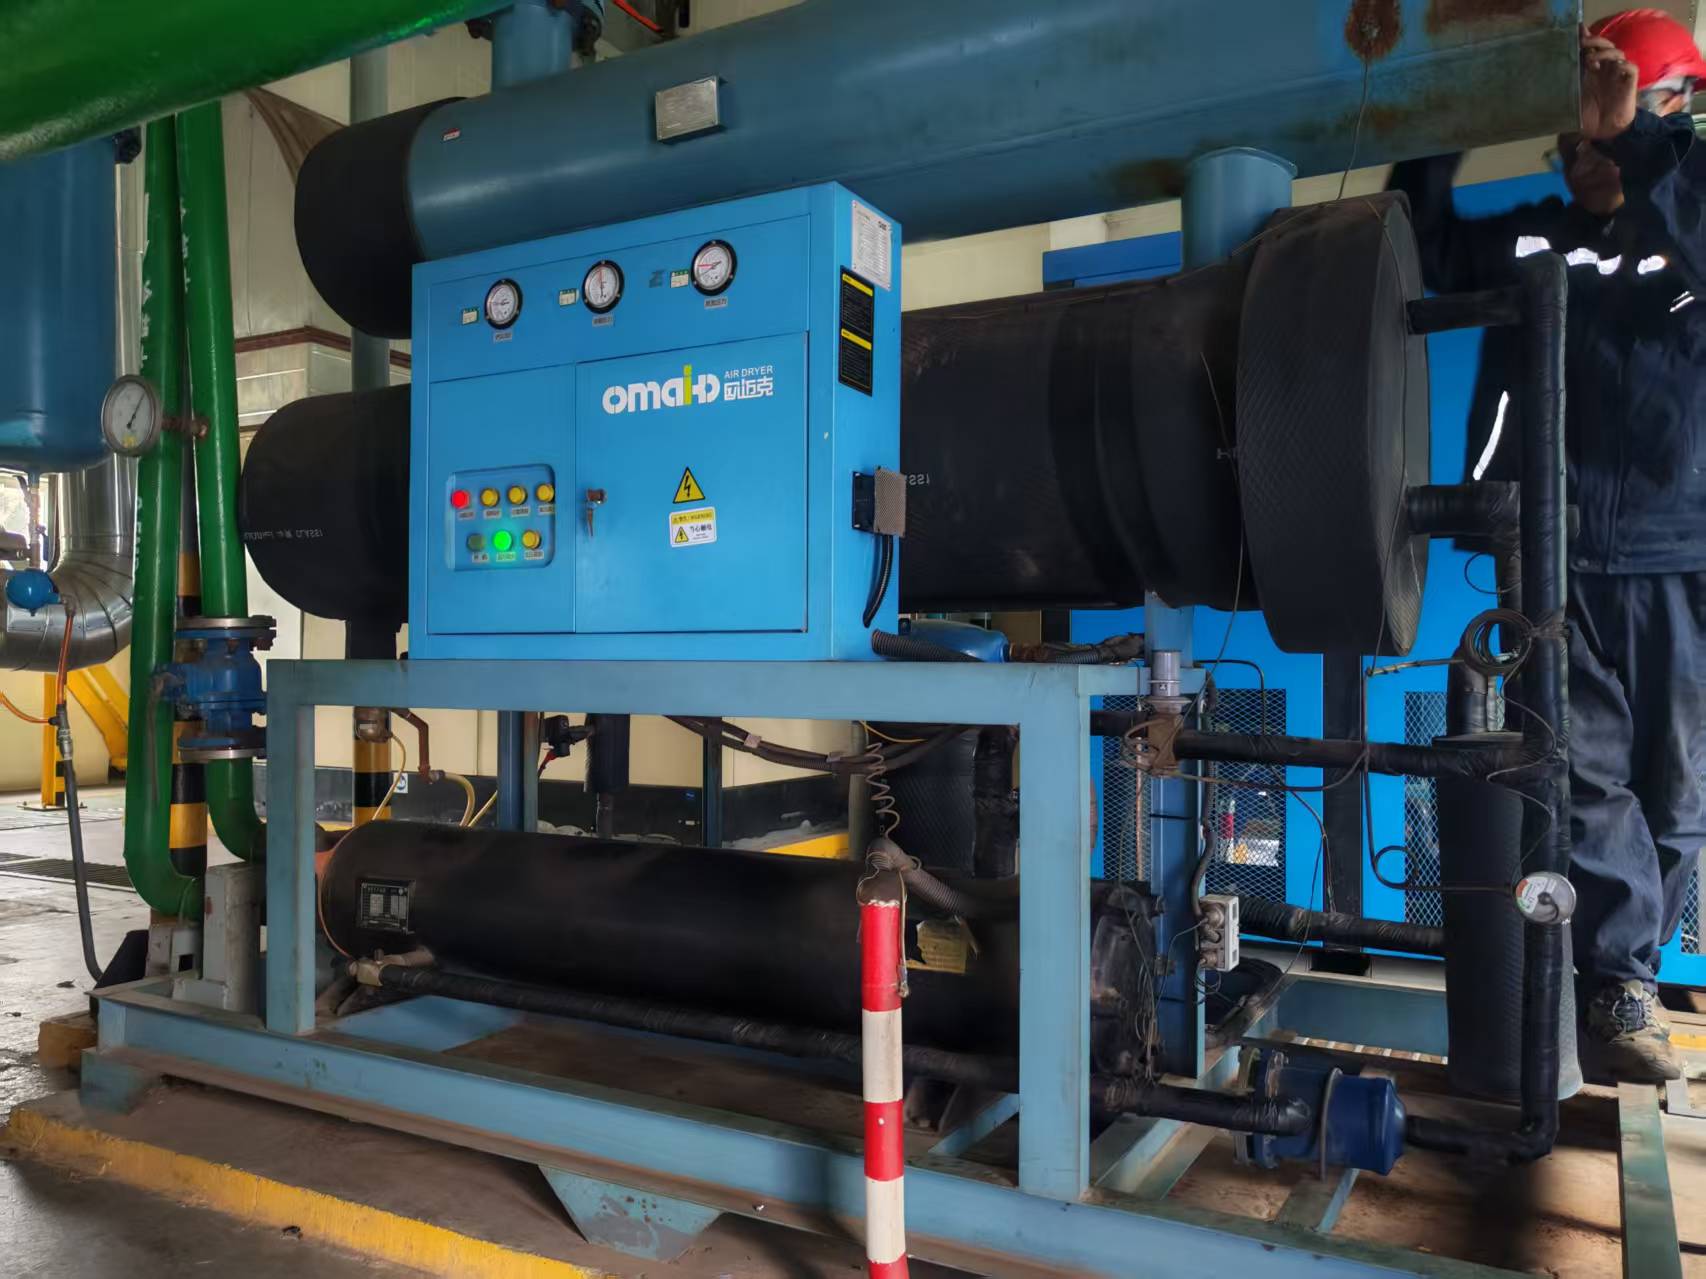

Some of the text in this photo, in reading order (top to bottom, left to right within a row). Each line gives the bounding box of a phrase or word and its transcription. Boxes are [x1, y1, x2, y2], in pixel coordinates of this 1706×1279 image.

[725, 365, 773, 379] AIR DRYER
[724, 376, 773, 400] 欧迈克
